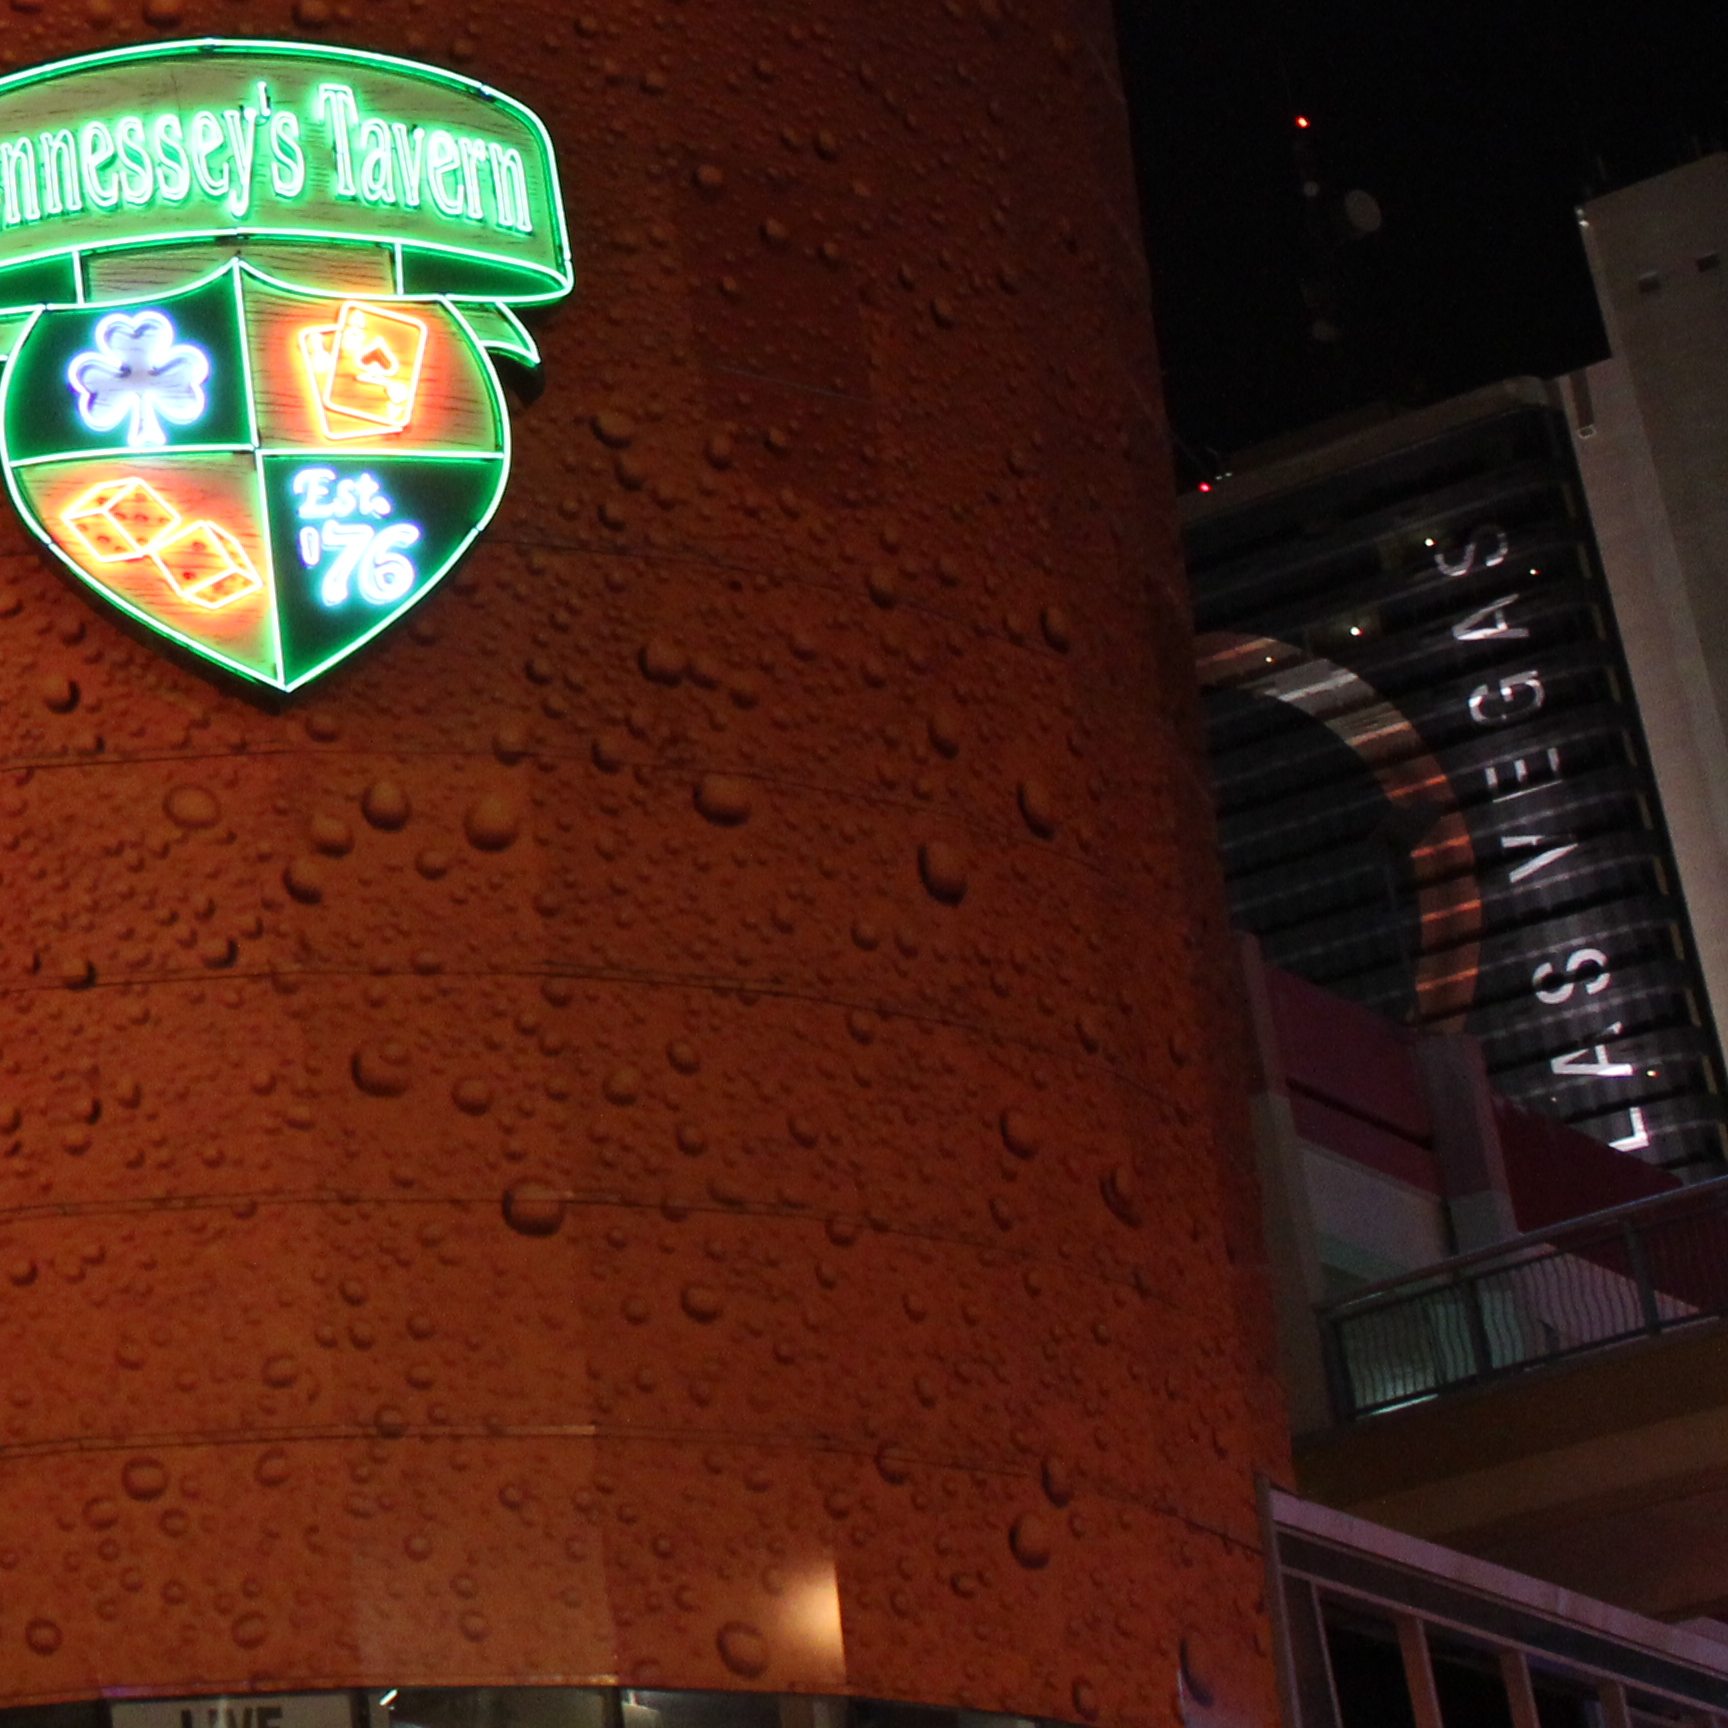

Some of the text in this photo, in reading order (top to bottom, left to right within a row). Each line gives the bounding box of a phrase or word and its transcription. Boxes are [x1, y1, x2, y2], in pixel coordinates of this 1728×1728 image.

[318, 83, 534, 235] Tavern
[292, 467, 393, 520] Est.
[298, 518, 421, 606] '76
[1434, 524, 1651, 1153] LAS VEGAS
